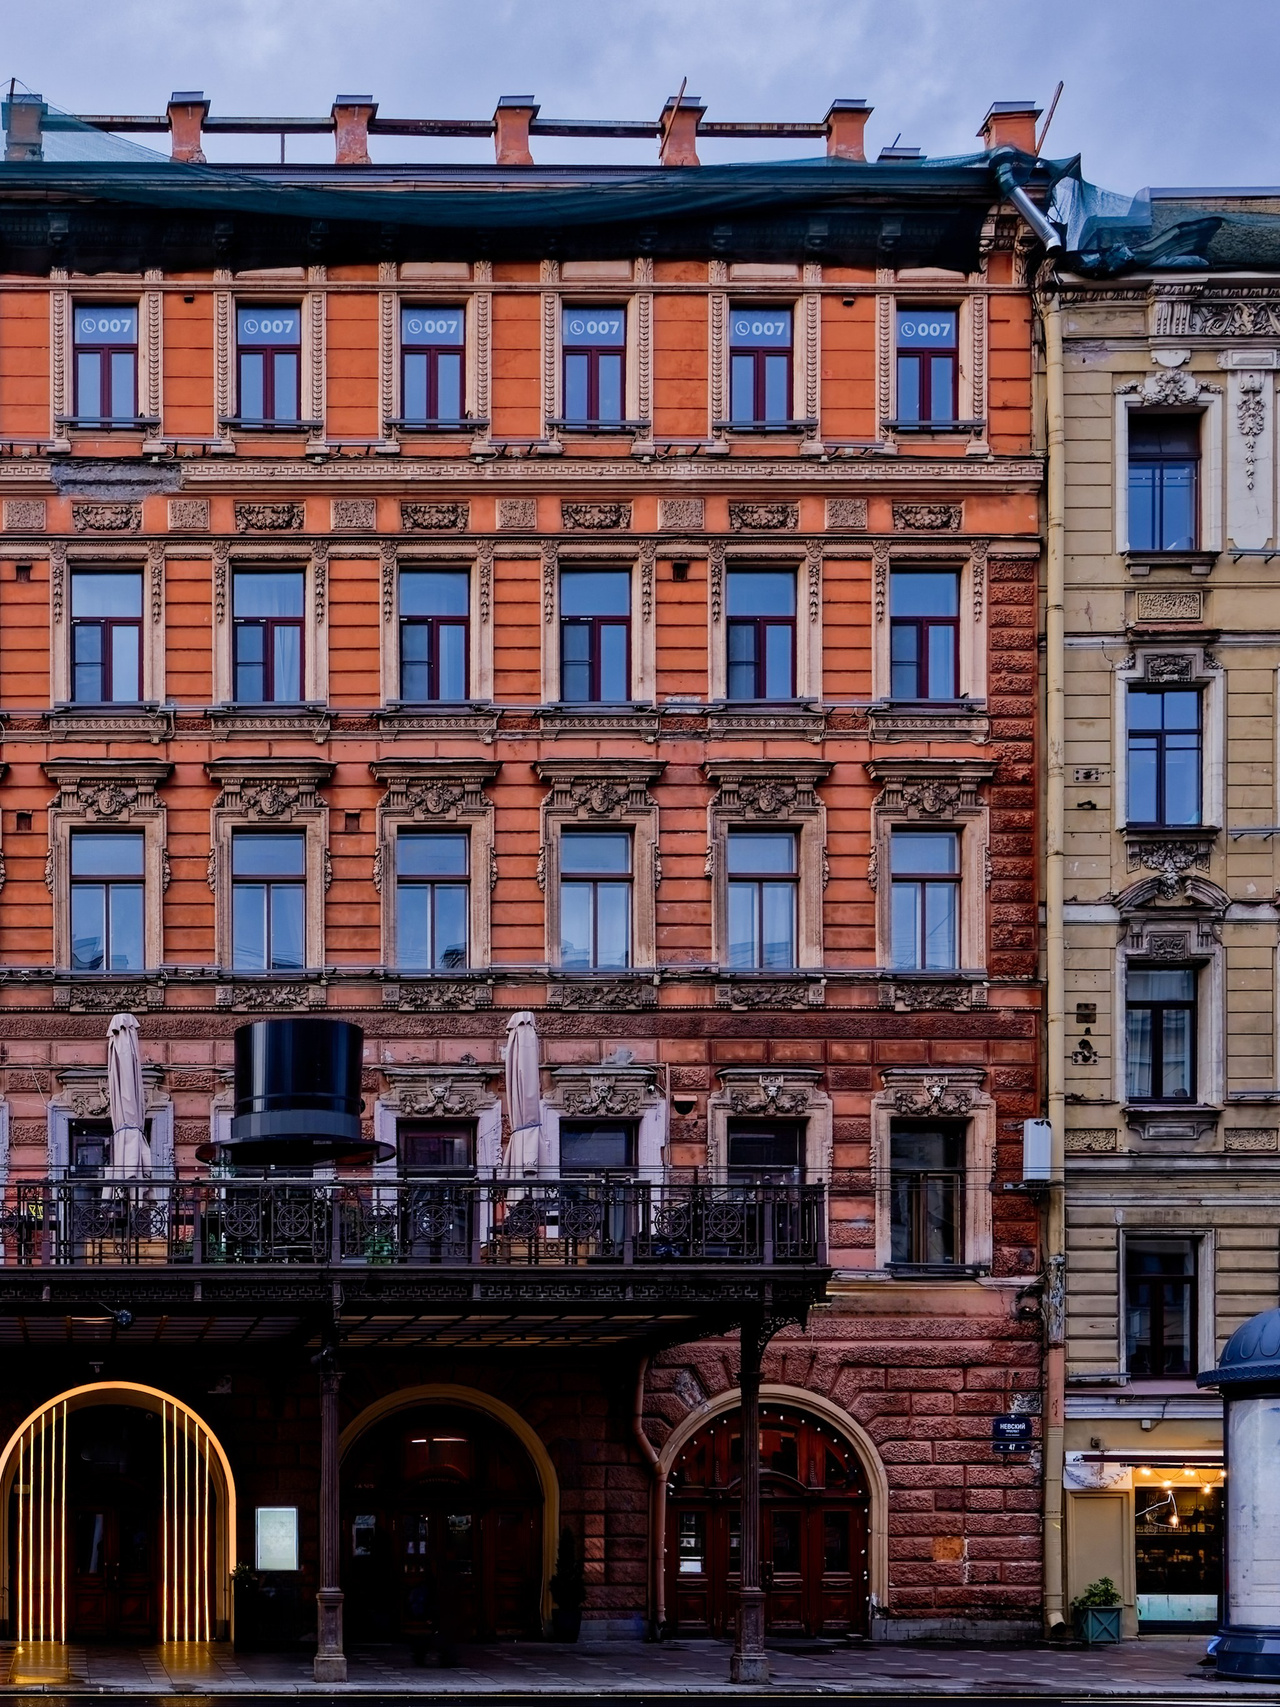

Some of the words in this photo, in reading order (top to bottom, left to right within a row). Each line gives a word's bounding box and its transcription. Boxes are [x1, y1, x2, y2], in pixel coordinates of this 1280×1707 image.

[98, 318, 132, 332] 007
[260, 320, 294, 334] 007
[424, 320, 458, 334] 007
[586, 320, 620, 334] 007
[751, 322, 785, 336] 007
[917, 323, 951, 337] 007
[1000, 1422, 1026, 1430] НЕВСКИЙ
